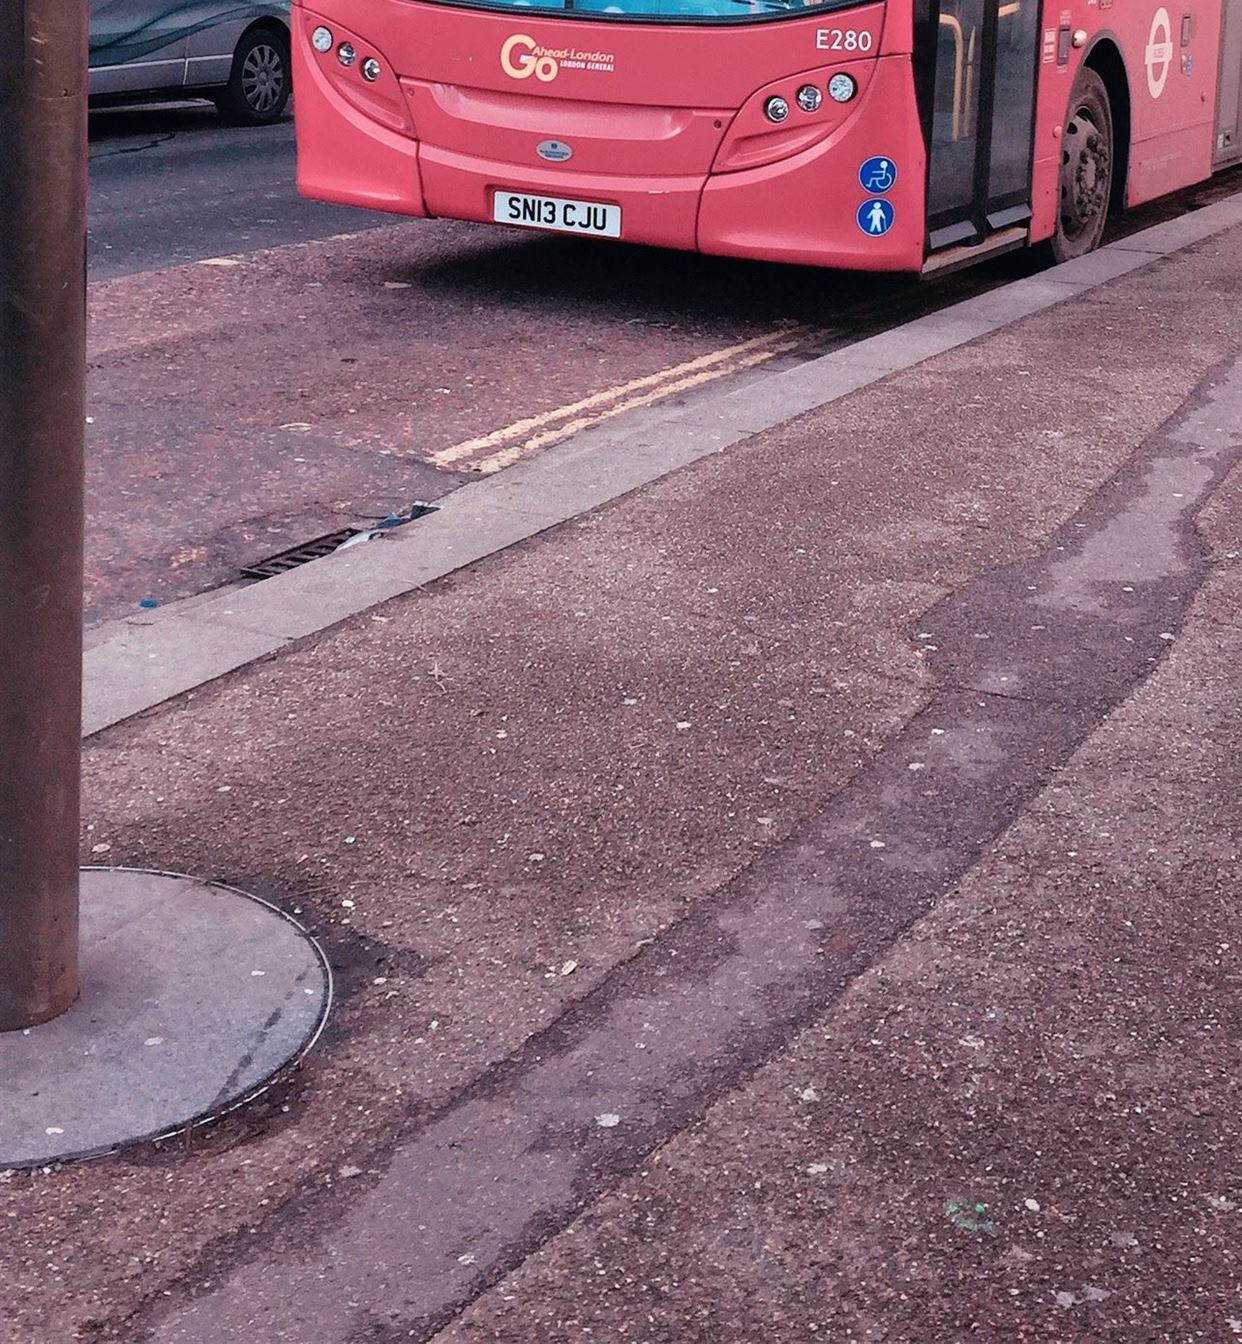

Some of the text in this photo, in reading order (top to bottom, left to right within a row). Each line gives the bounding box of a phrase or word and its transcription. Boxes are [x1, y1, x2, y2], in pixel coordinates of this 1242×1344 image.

[816, 29, 872, 52] E280
[500, 34, 559, 82] Go
[532, 46, 615, 63] Ahead-London
[560, 59, 615, 73] LONDON GENERAL
[508, 196, 607, 231] SN13 CJU
